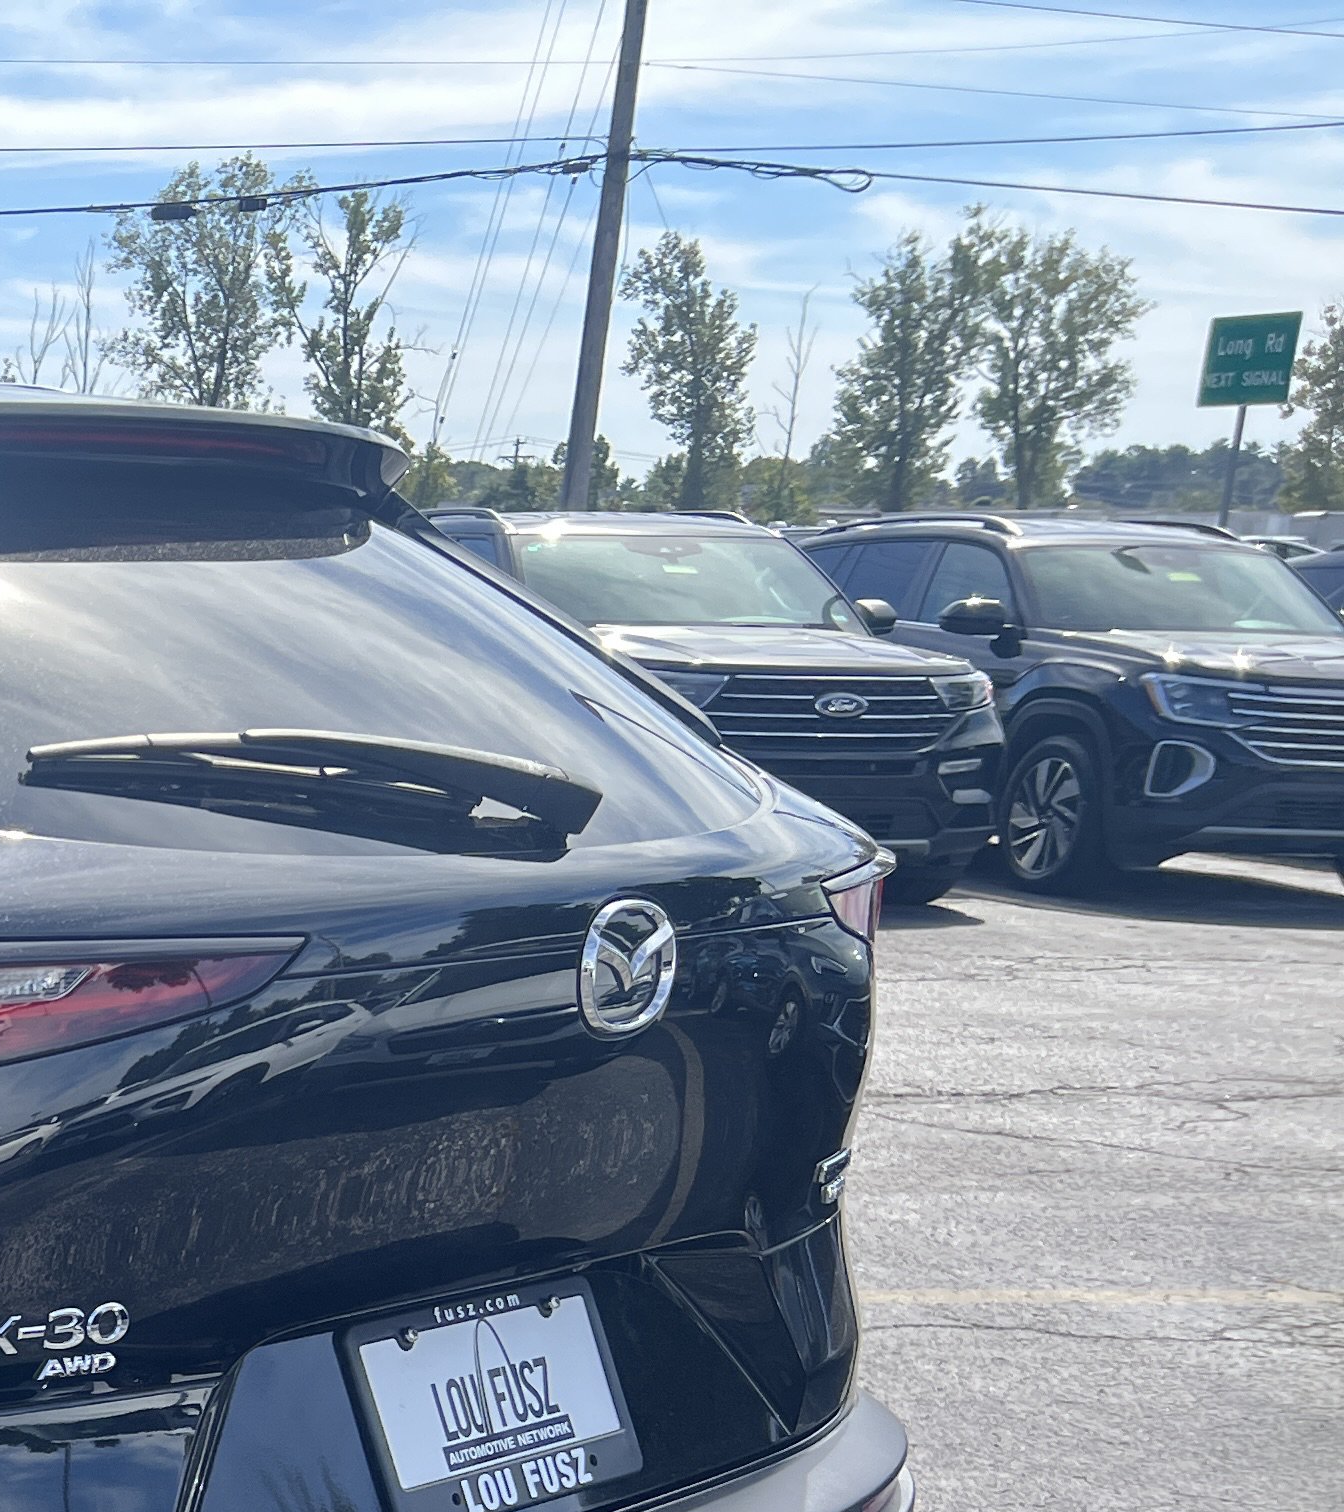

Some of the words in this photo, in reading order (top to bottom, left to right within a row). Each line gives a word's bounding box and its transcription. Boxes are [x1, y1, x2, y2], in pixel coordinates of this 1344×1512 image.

[1217, 336, 1253, 360] Long
[1265, 333, 1286, 353] Rd
[1204, 371, 1235, 389] NEXT
[1241, 369, 1285, 387] SIGNAL
[433, 1293, 520, 1324] fusz.com
[34, 1351, 117, 1381] AWD
[430, 1373, 486, 1442] LOU
[487, 1356, 561, 1427] FUSZ
[449, 1438, 516, 1466] AUTOMOTIVE
[518, 1420, 572, 1447] NETWORK
[521, 1447, 593, 1499] FUSZ
